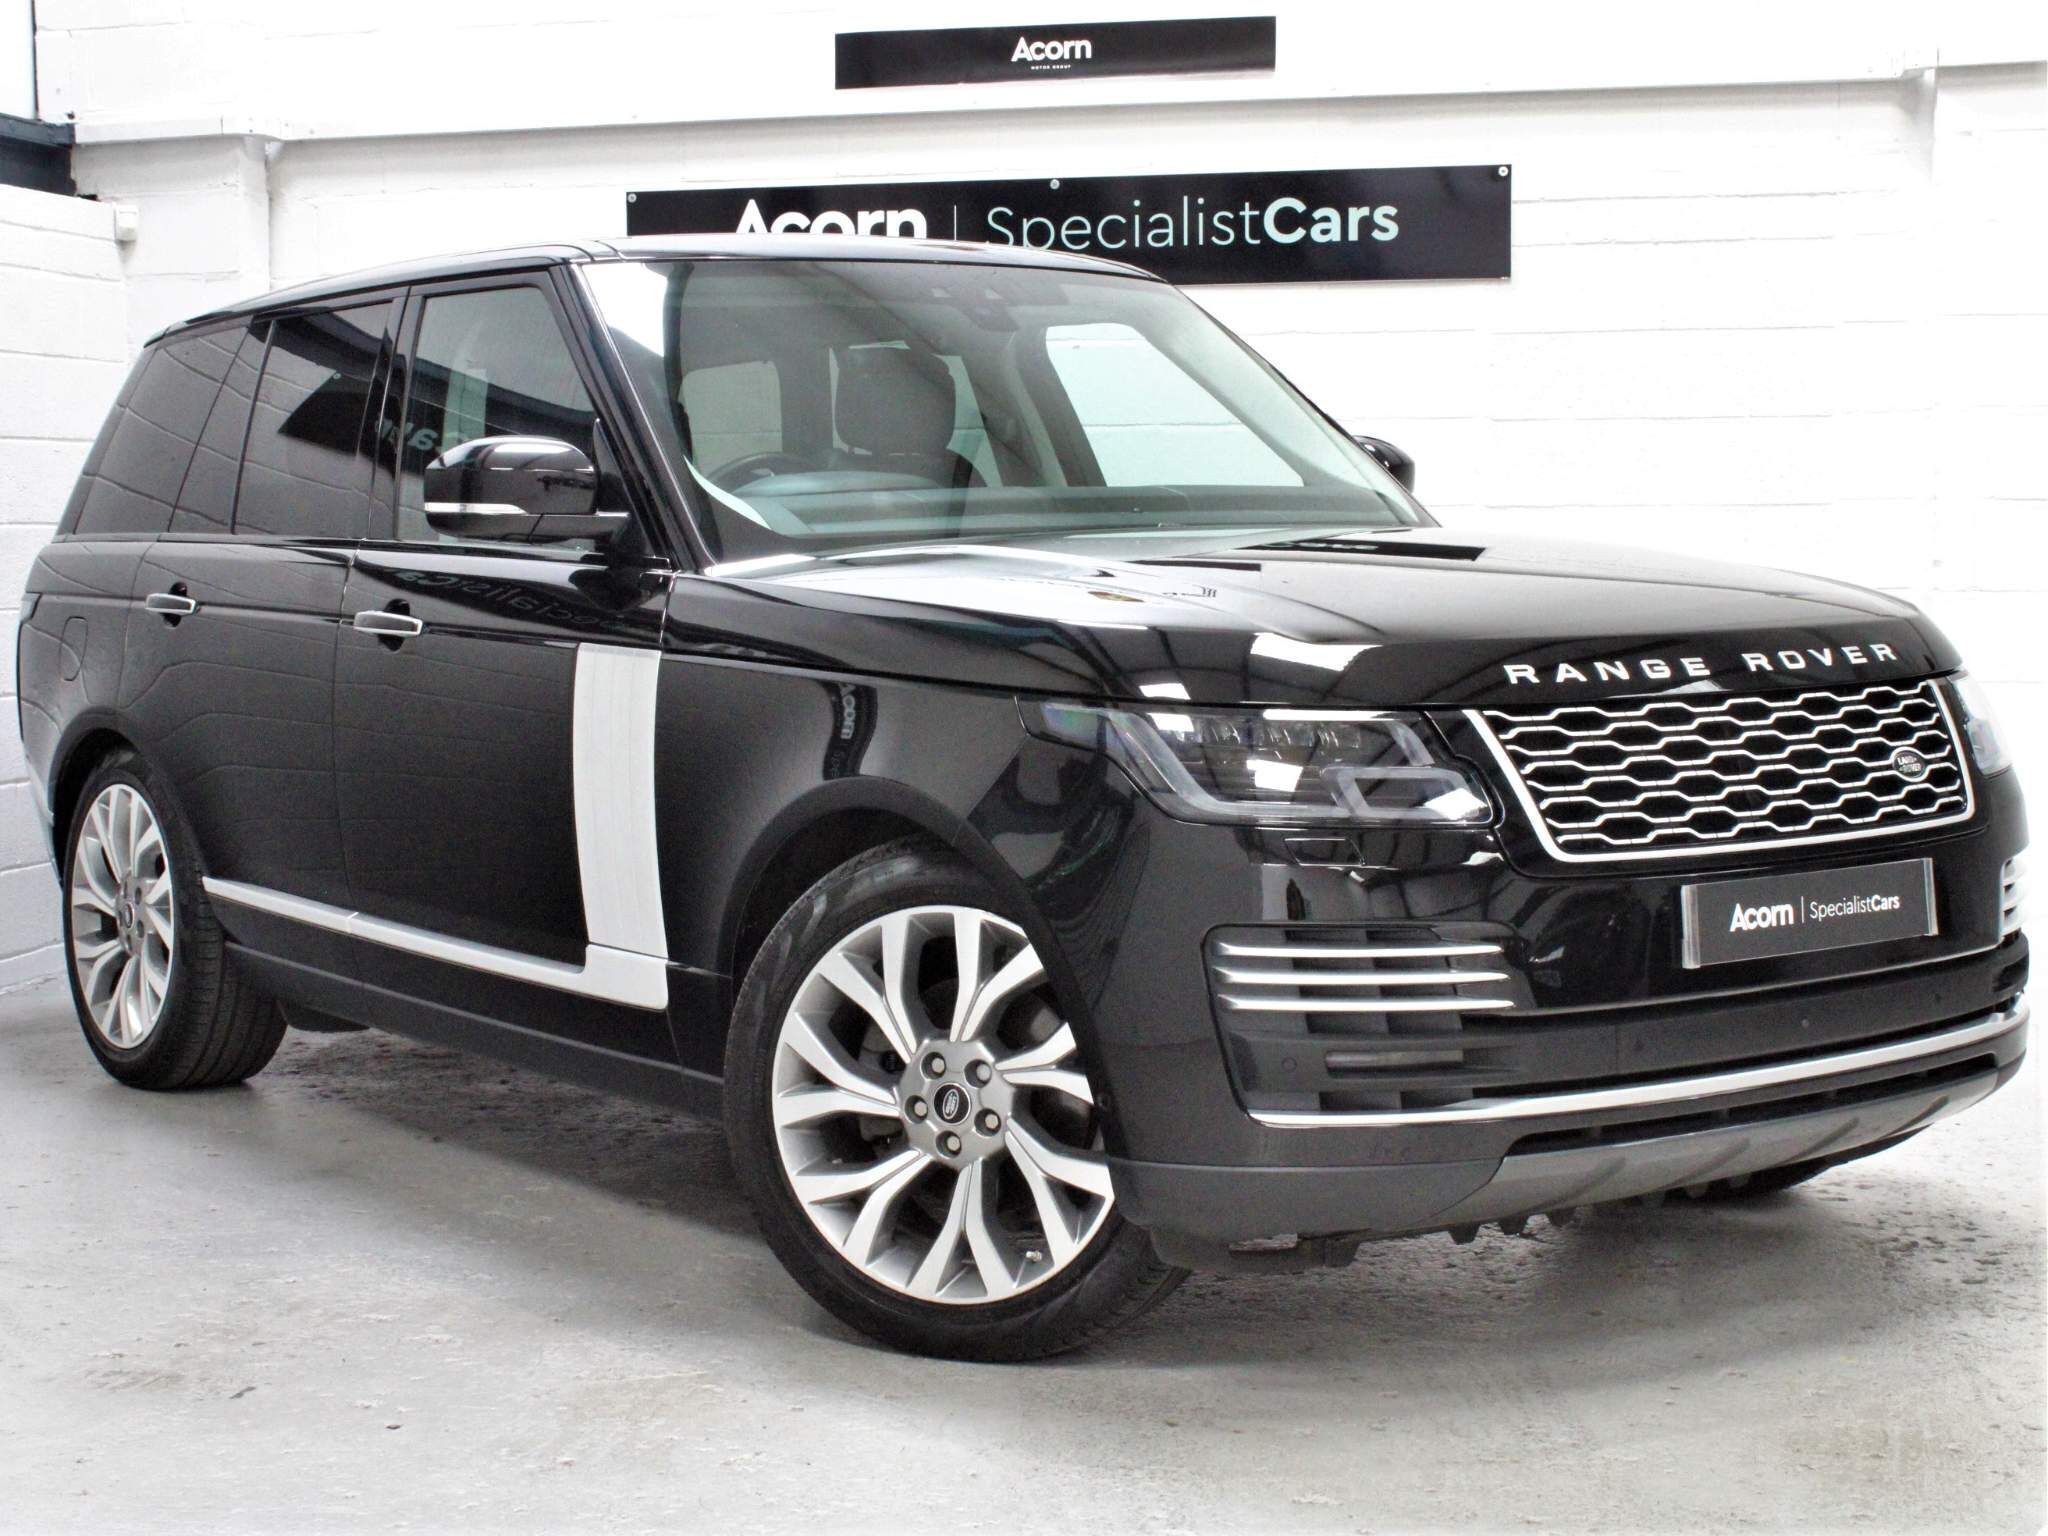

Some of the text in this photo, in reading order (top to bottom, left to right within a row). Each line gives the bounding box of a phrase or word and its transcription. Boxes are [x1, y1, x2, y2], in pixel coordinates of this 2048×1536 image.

[1010, 36, 1092, 62] Acorn
[986, 195, 1399, 251] SpecialistCars
[1503, 643, 1897, 685] RANGE ROVER
[1729, 894, 1900, 932] Acorn SpecialistCars
